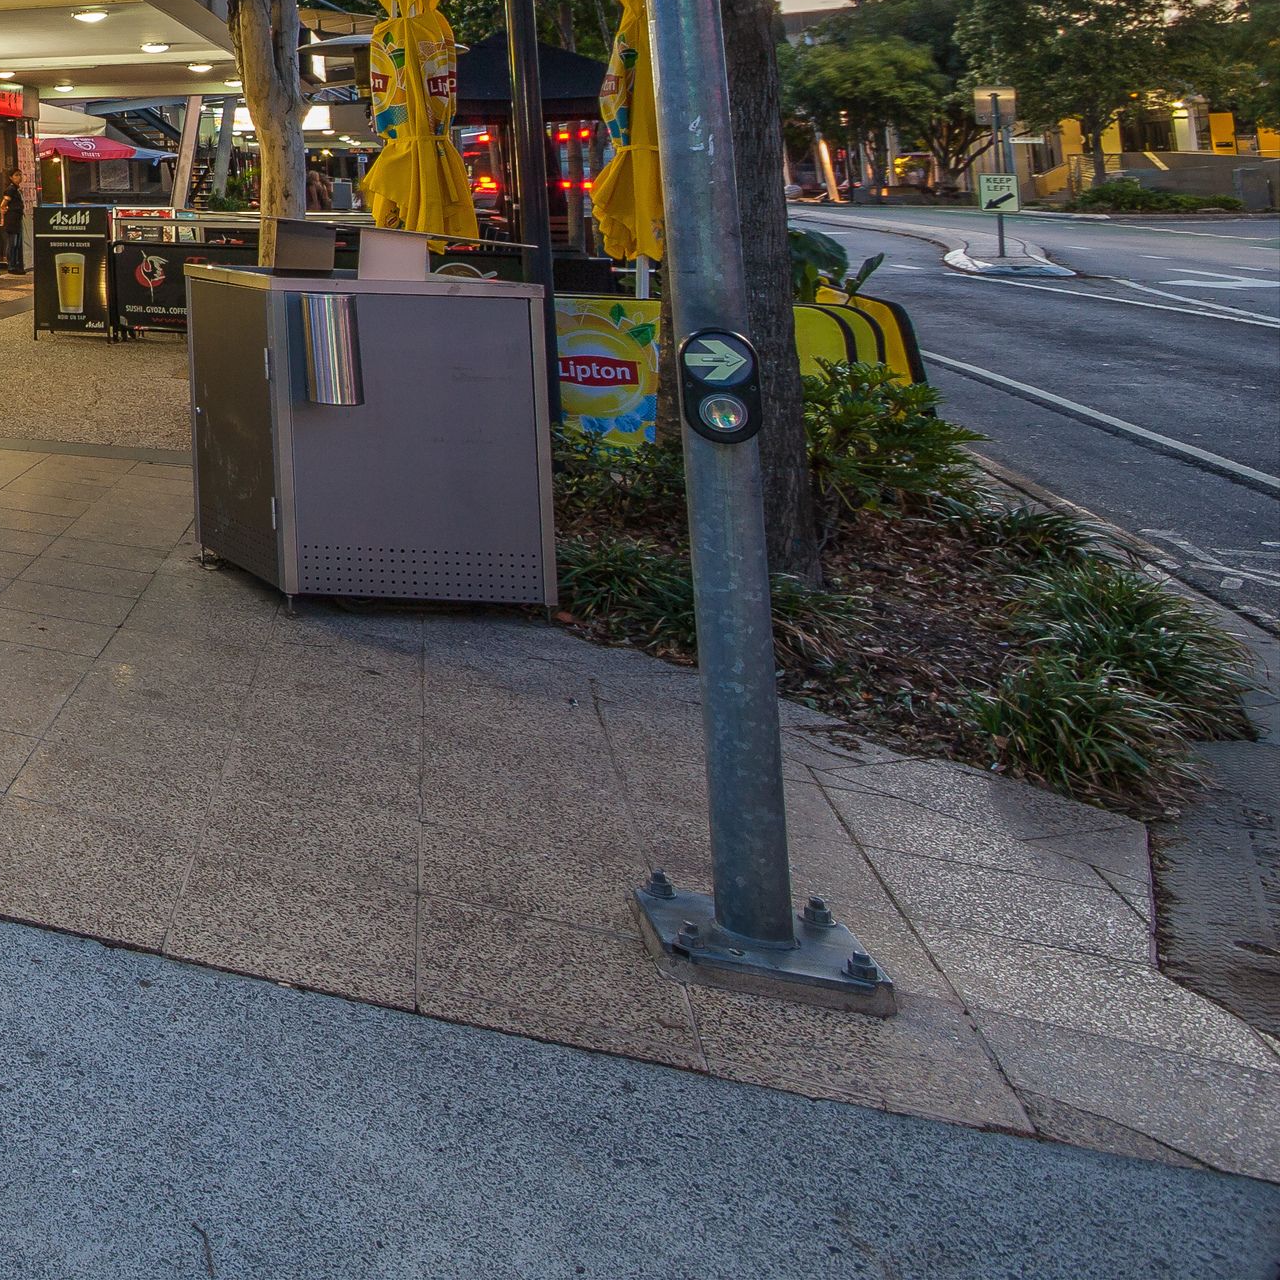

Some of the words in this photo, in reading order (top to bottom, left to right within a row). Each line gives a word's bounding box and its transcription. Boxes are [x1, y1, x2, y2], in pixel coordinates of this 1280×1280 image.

[985, 177, 1012, 185] KEEP
[48, 210, 90, 226] Asahi
[85, 320, 105, 329] Asahi
[558, 360, 632, 382] Lipton
